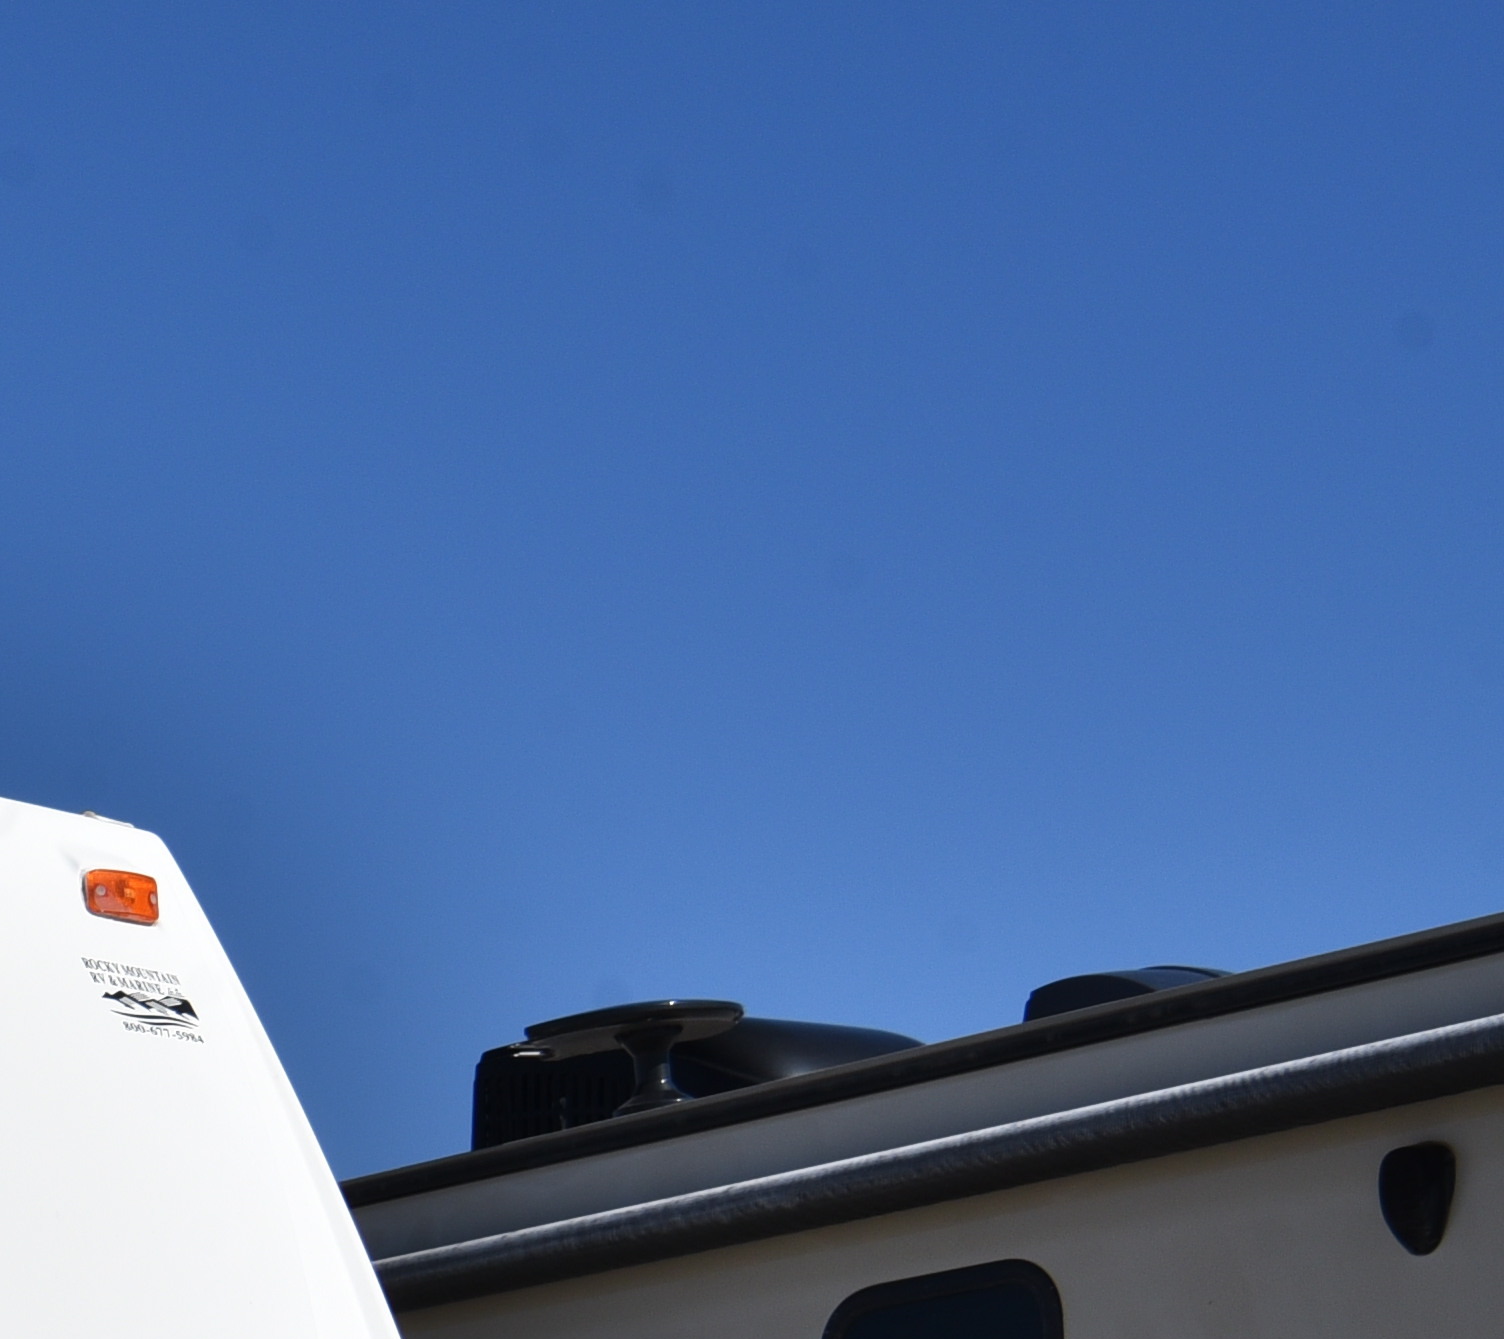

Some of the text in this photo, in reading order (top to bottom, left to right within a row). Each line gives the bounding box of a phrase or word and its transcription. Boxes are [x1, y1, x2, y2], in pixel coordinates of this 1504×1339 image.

[81, 956, 181, 985] ROCKY MOUNTAIN
[89, 971, 106, 984] RV
[116, 976, 165, 995] MARINE
